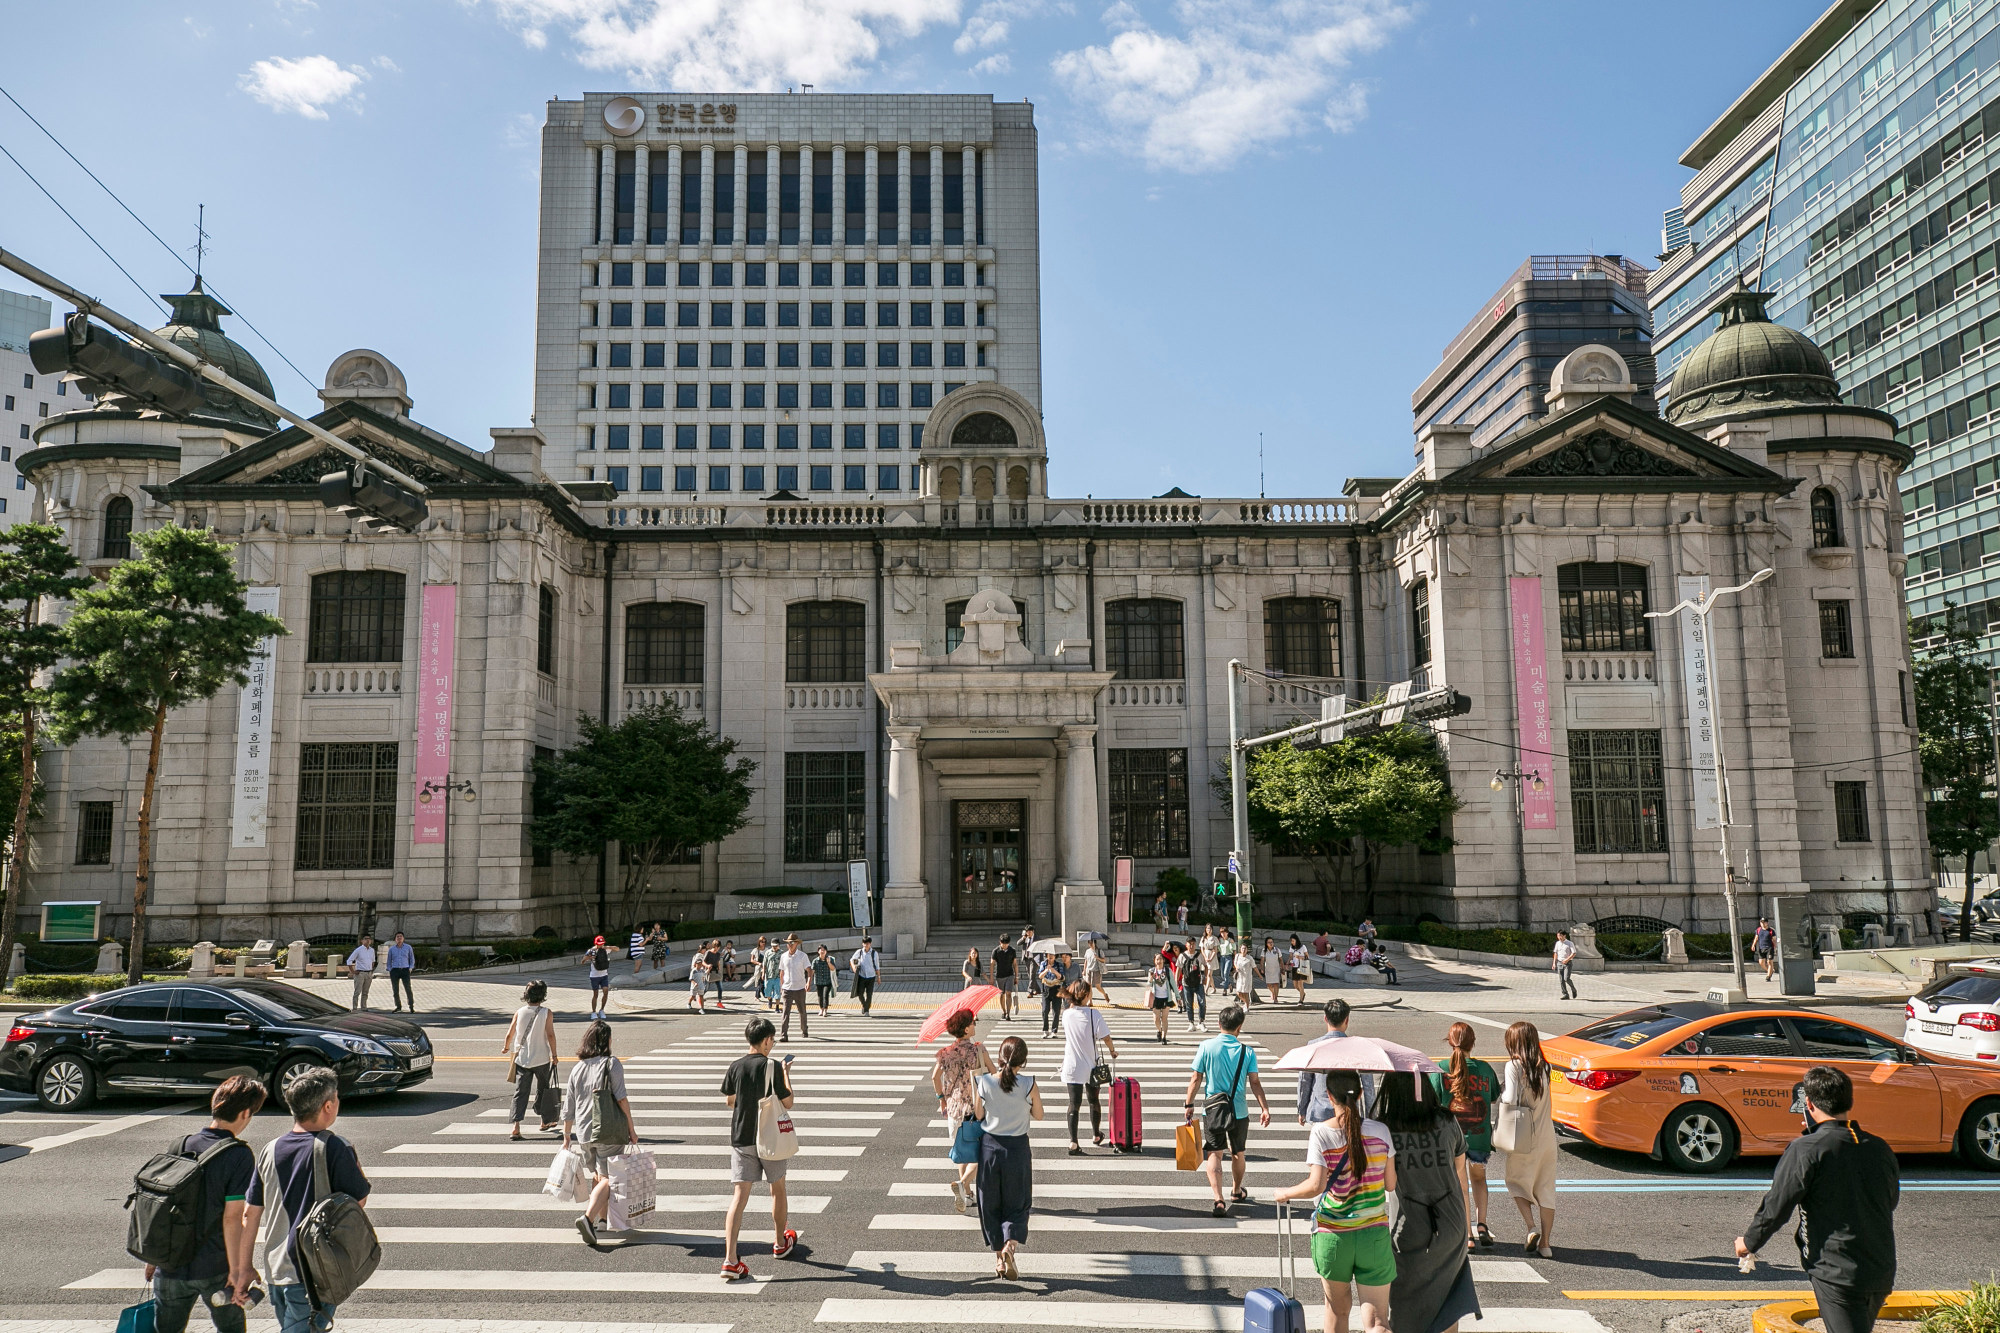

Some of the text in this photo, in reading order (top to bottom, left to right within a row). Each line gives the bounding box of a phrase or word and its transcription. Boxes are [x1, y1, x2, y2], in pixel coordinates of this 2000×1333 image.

[657, 103, 737, 123] 한국은행
[420, 612, 430, 658] Collection
[1521, 613, 1531, 646] 한국은행
[430, 621, 440, 675] 한국은행 소장
[1530, 665, 1548, 745] 미술 명품전
[433, 675, 449, 757] 미술 명품전
[1699, 716, 1711, 742] 흐름
[248, 733, 261, 758] 흐름
[766, 901, 799, 910] 화폐박물관
[1709, 992, 1723, 1001] TAXI
[1645, 1078, 1678, 1086] HAECHI
[1651, 1085, 1679, 1093] SEOUL
[1742, 1088, 1789, 1098] HAECHI
[1743, 1098, 1782, 1108] SEOUL
[1392, 1130, 1442, 1151] BABY
[1395, 1150, 1449, 1171] FACE
